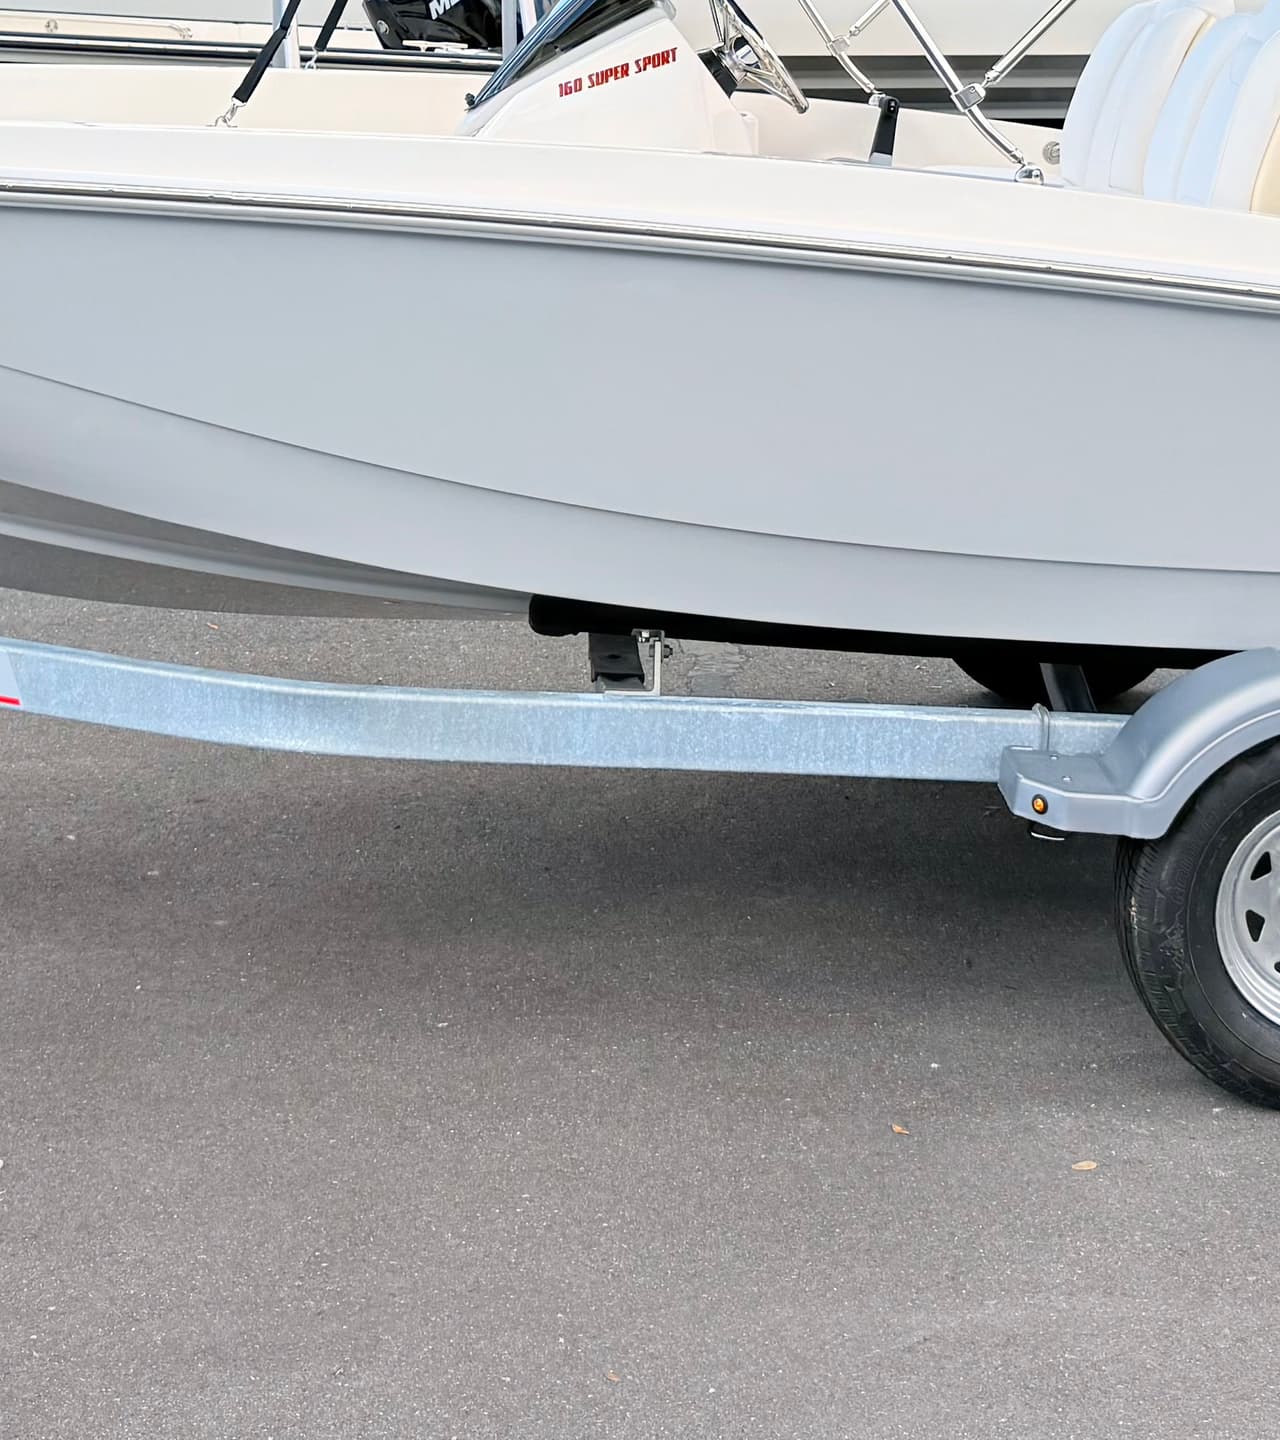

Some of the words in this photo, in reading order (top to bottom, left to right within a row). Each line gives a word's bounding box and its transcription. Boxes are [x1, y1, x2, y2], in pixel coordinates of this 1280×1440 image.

[558, 77, 583, 98] 160
[587, 62, 630, 89] SUPER
[634, 46, 678, 74] SPORT
